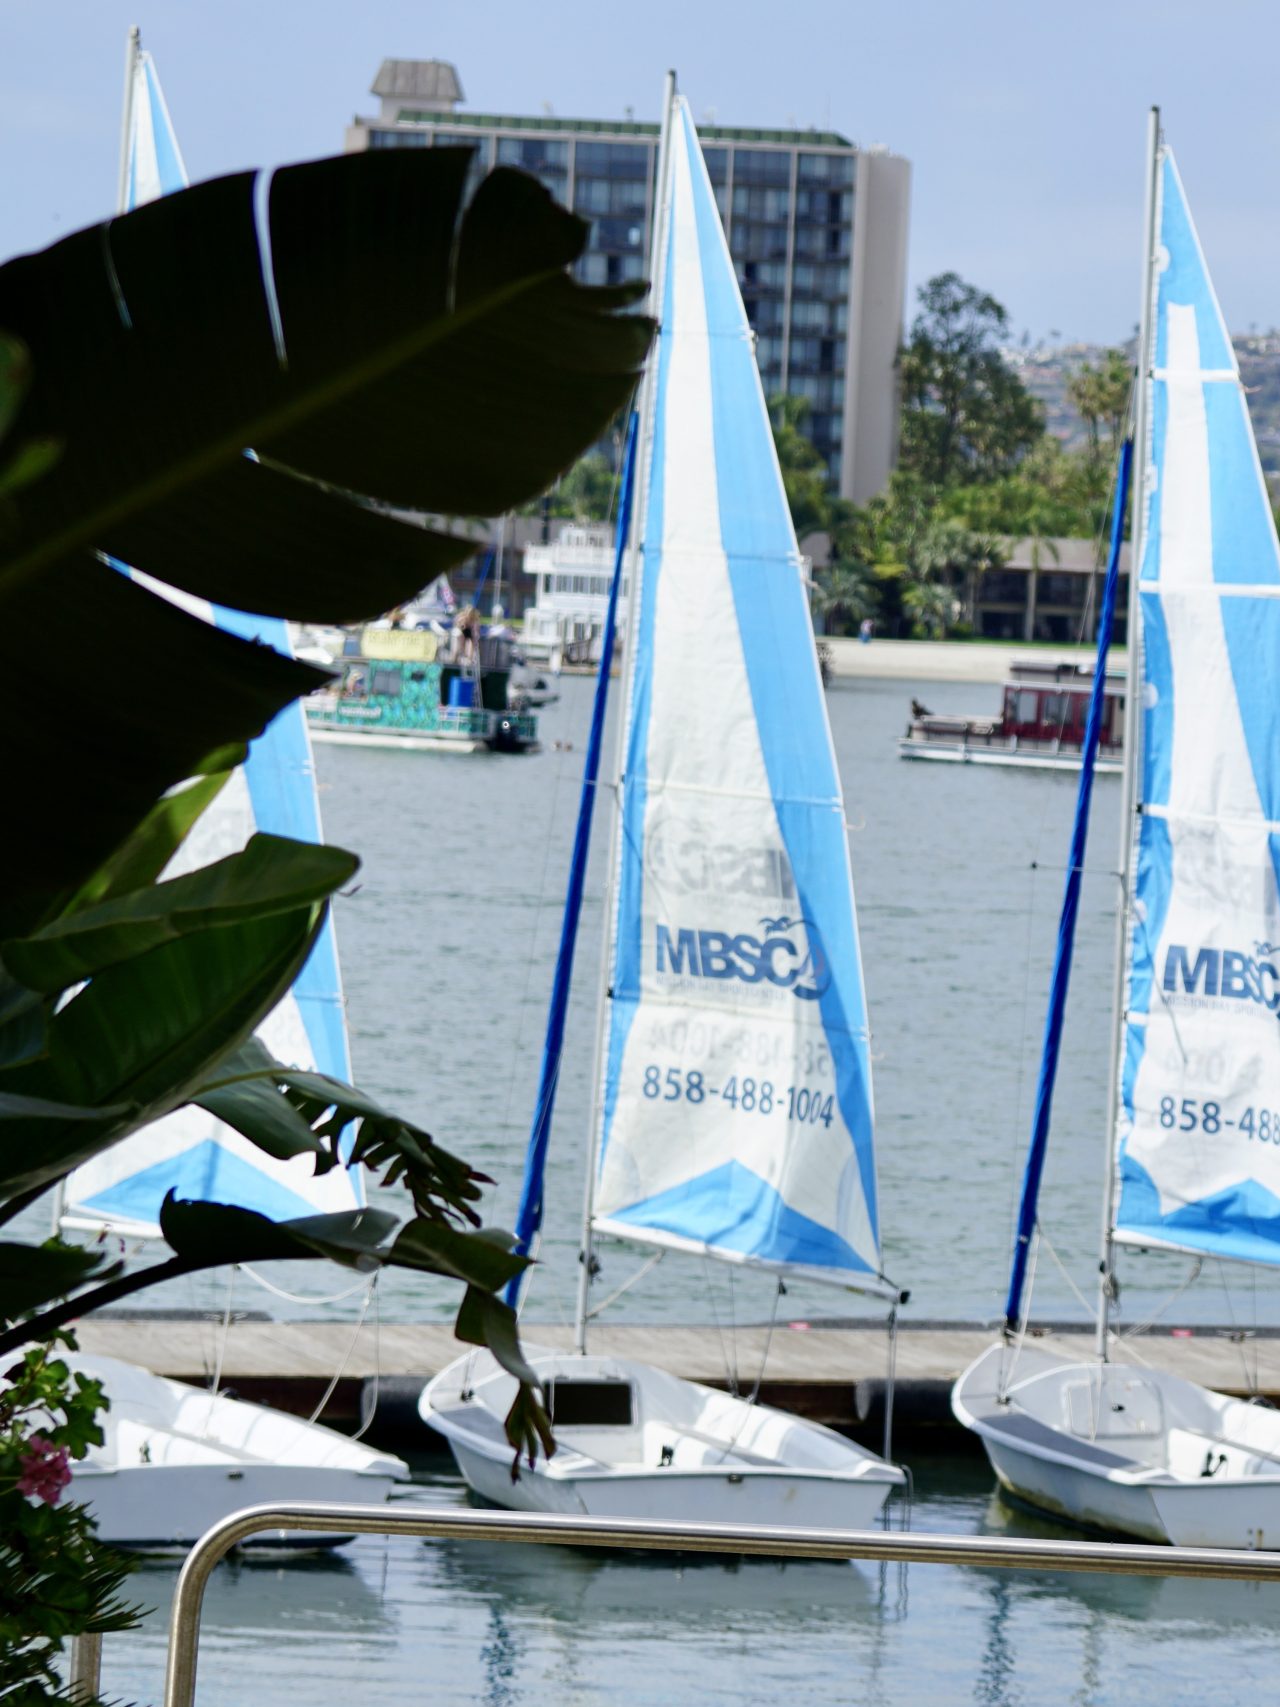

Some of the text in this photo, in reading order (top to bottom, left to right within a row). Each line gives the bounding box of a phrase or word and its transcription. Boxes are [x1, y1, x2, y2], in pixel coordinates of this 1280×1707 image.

[656, 924, 799, 986] MBSC
[1163, 944, 1280, 1010] MBSC
[643, 1065, 835, 1129] 858-488-1004
